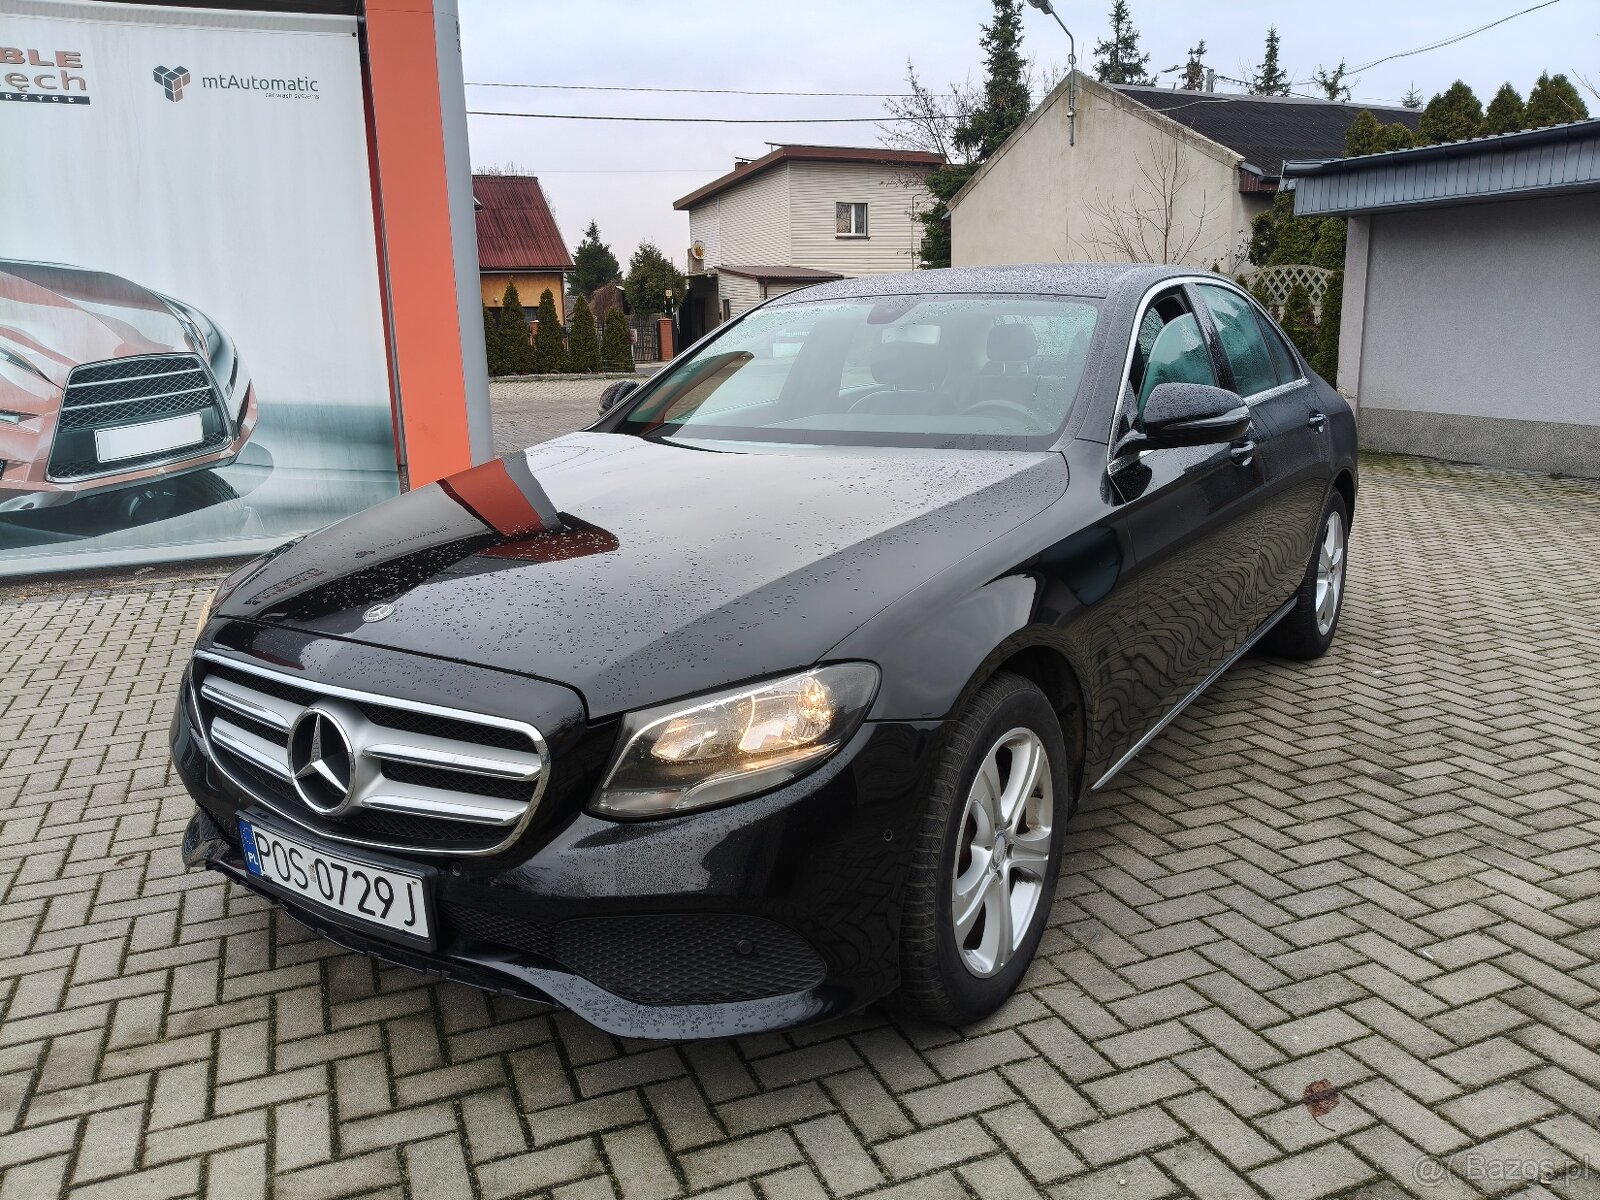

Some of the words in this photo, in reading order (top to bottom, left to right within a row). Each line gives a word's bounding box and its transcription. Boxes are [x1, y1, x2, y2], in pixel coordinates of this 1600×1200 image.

[0, 69, 87, 92] ęch
[202, 74, 319, 92] mtAutomatic
[247, 851, 259, 866] PL
[254, 831, 309, 890] POS
